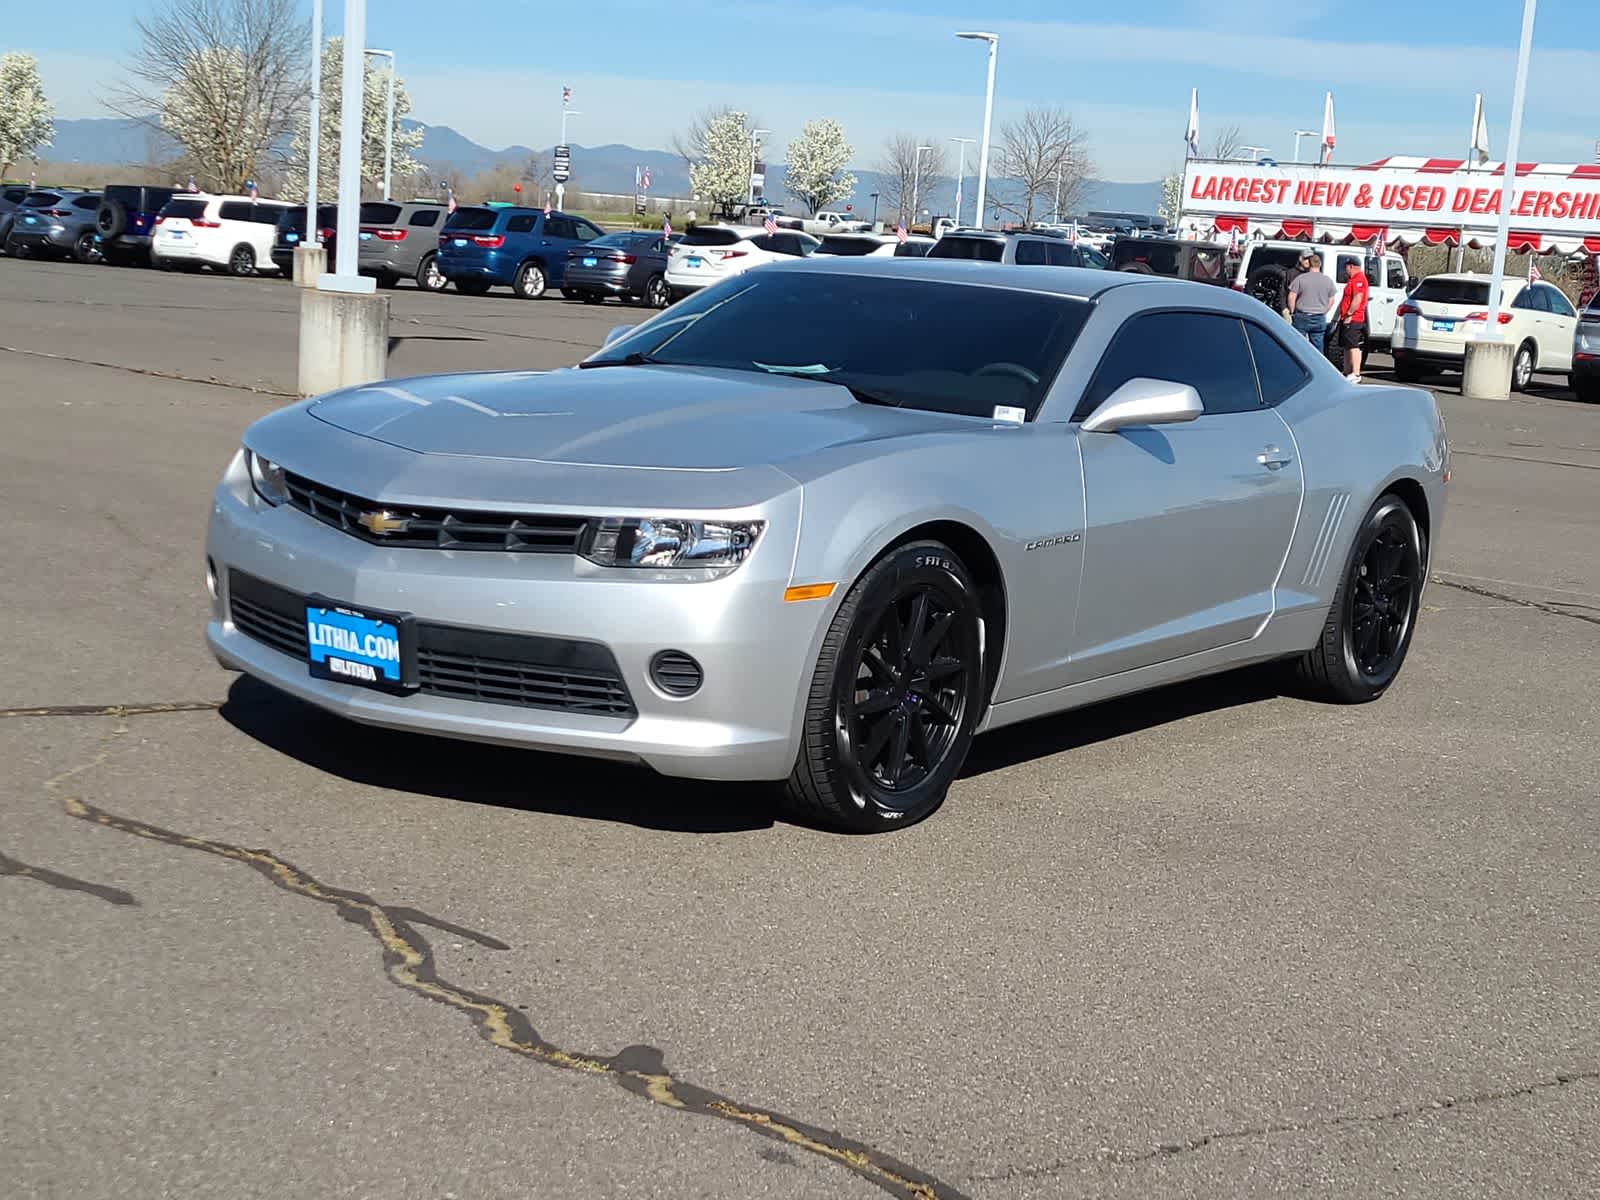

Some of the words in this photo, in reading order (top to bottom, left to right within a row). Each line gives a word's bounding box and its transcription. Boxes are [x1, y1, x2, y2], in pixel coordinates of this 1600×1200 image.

[1190, 175, 1292, 204] LARGEST
[1293, 180, 1351, 207] NEW
[1353, 183, 1374, 208] &
[1380, 184, 1446, 212] USED
[1451, 187, 1600, 220] DEAERSHI
[1024, 533, 1081, 552] CAMARO
[308, 622, 400, 663] LITHIA.COM
